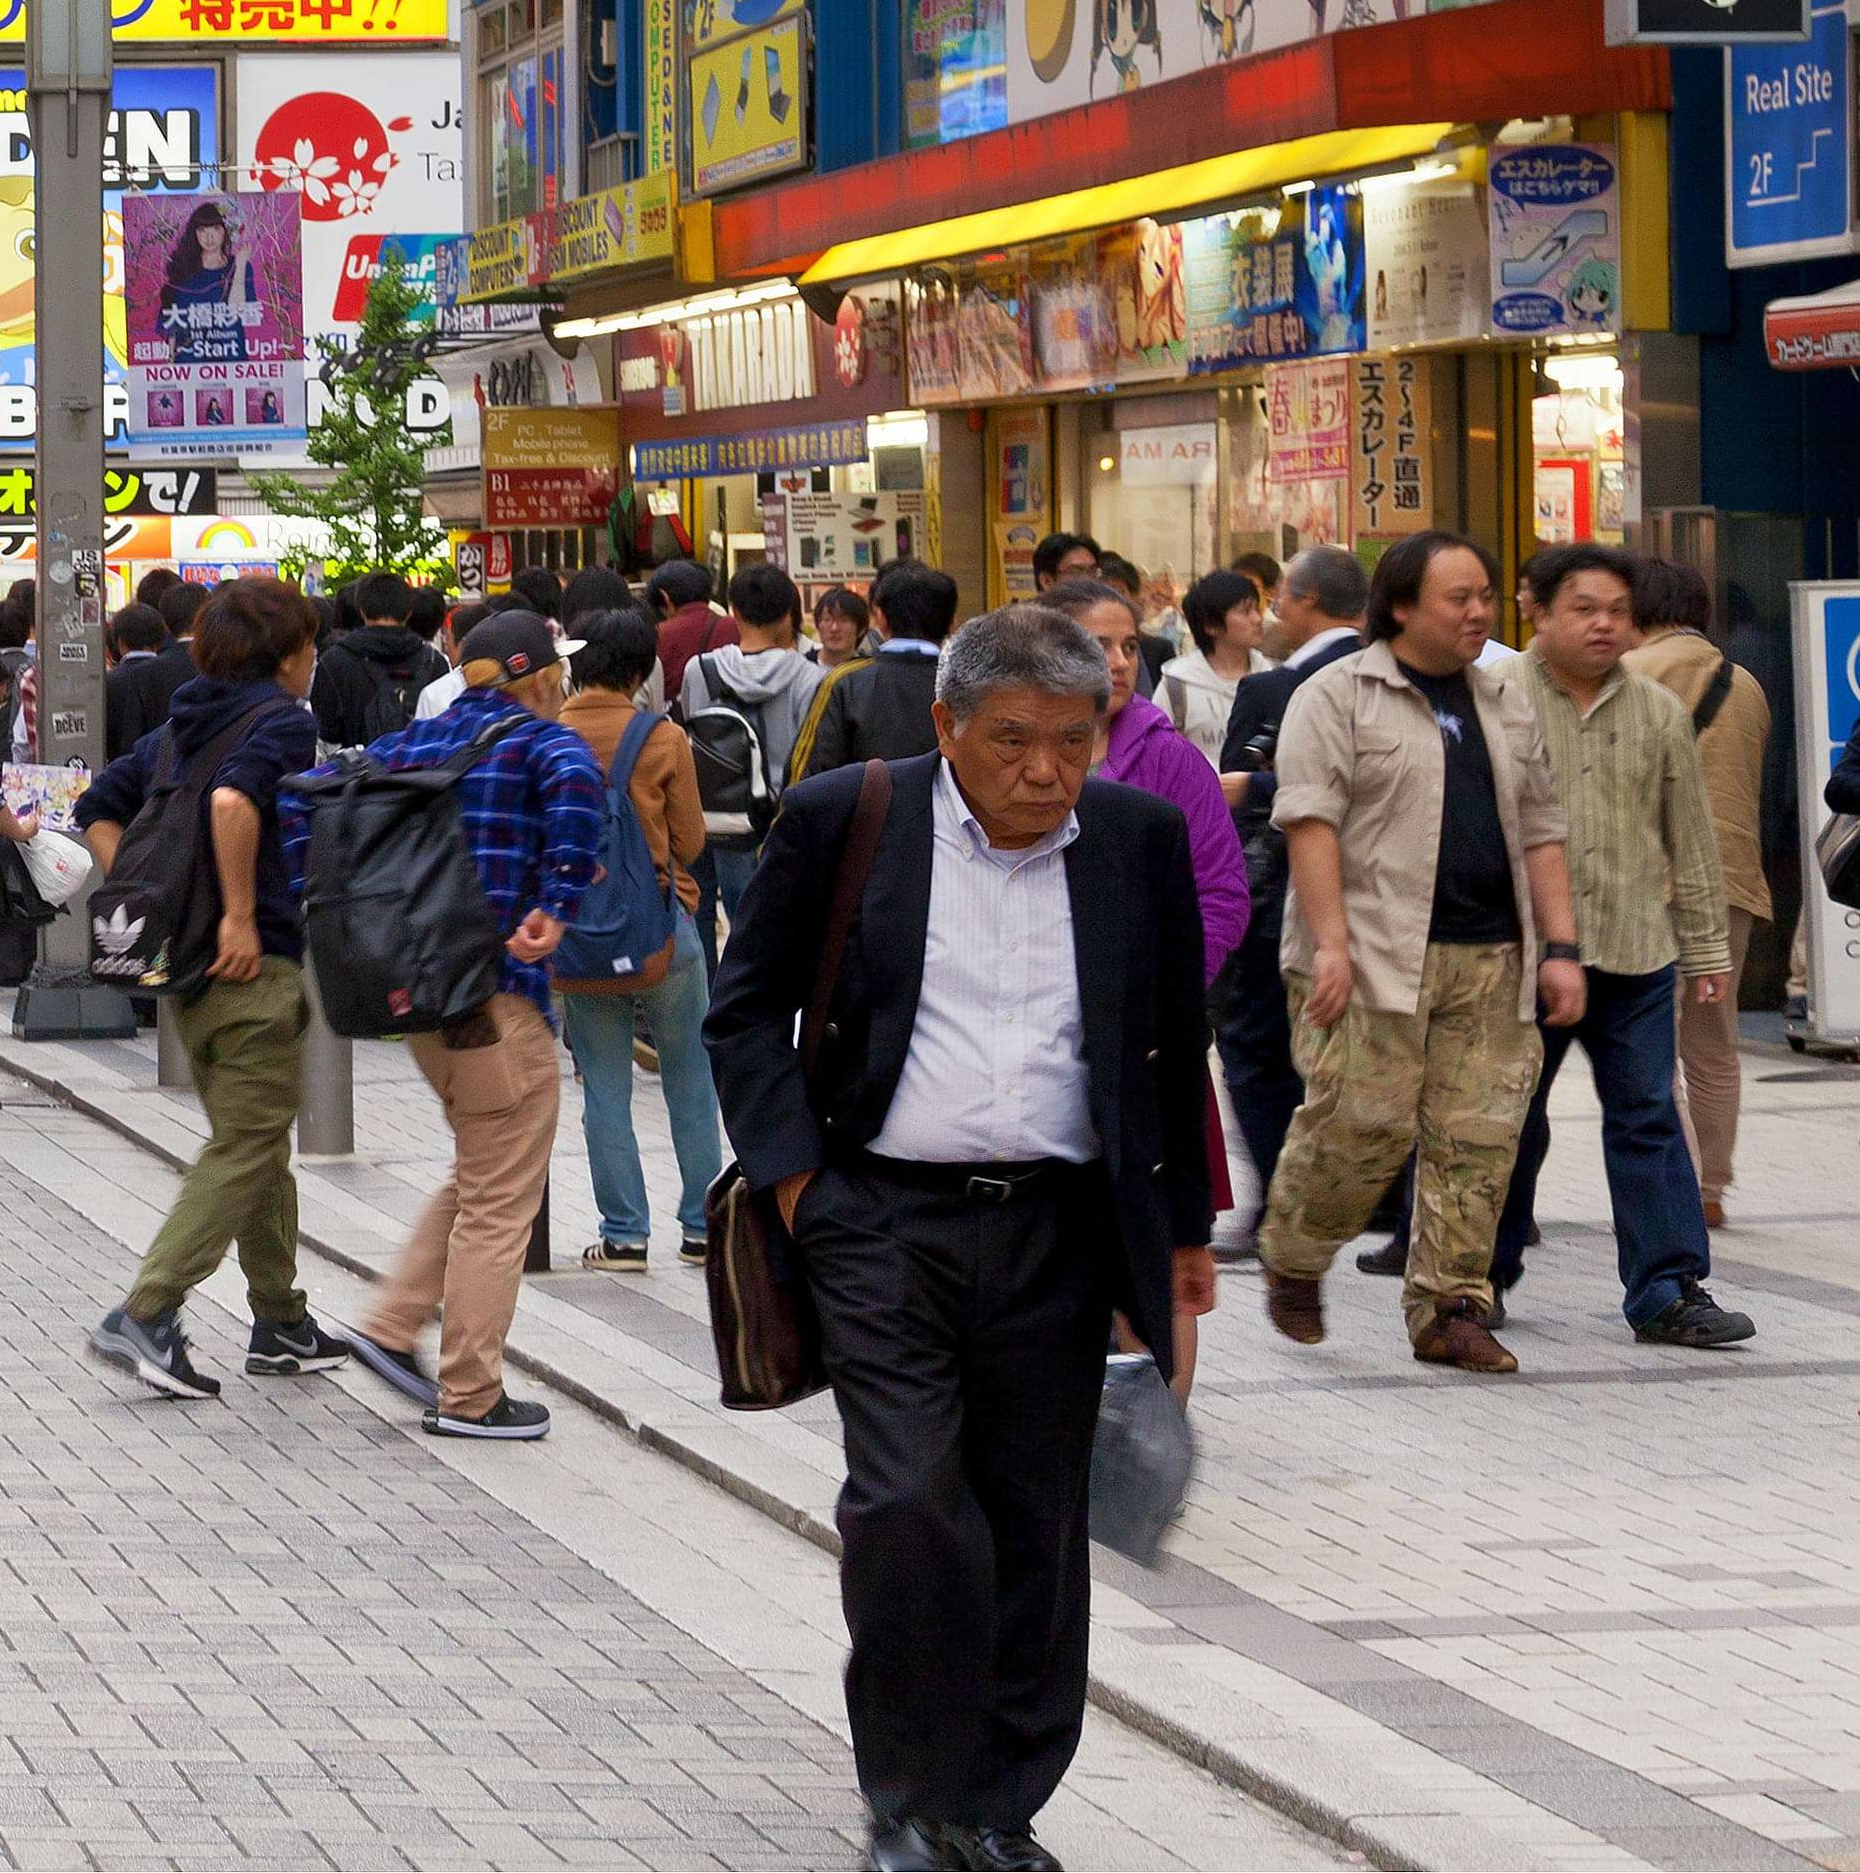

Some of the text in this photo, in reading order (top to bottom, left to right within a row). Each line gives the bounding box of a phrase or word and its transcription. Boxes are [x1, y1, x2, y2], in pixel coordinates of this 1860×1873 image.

[1746, 65, 1833, 115] Real Site
[1498, 160, 1609, 178] エスカレーター
[1749, 152, 1773, 196] 2F
[162, 302, 265, 329] 大橋彩香
[146, 364, 285, 382] NOW ON SALE!
[486, 413, 511, 431] 2F
[517, 422, 584, 438] PC Tablet
[512, 437, 589, 454] Mobile phone
[1359, 361, 1385, 529] エスカレーター
[492, 451, 611, 466] Tax-free & Discount
[491, 474, 512, 492] B1
